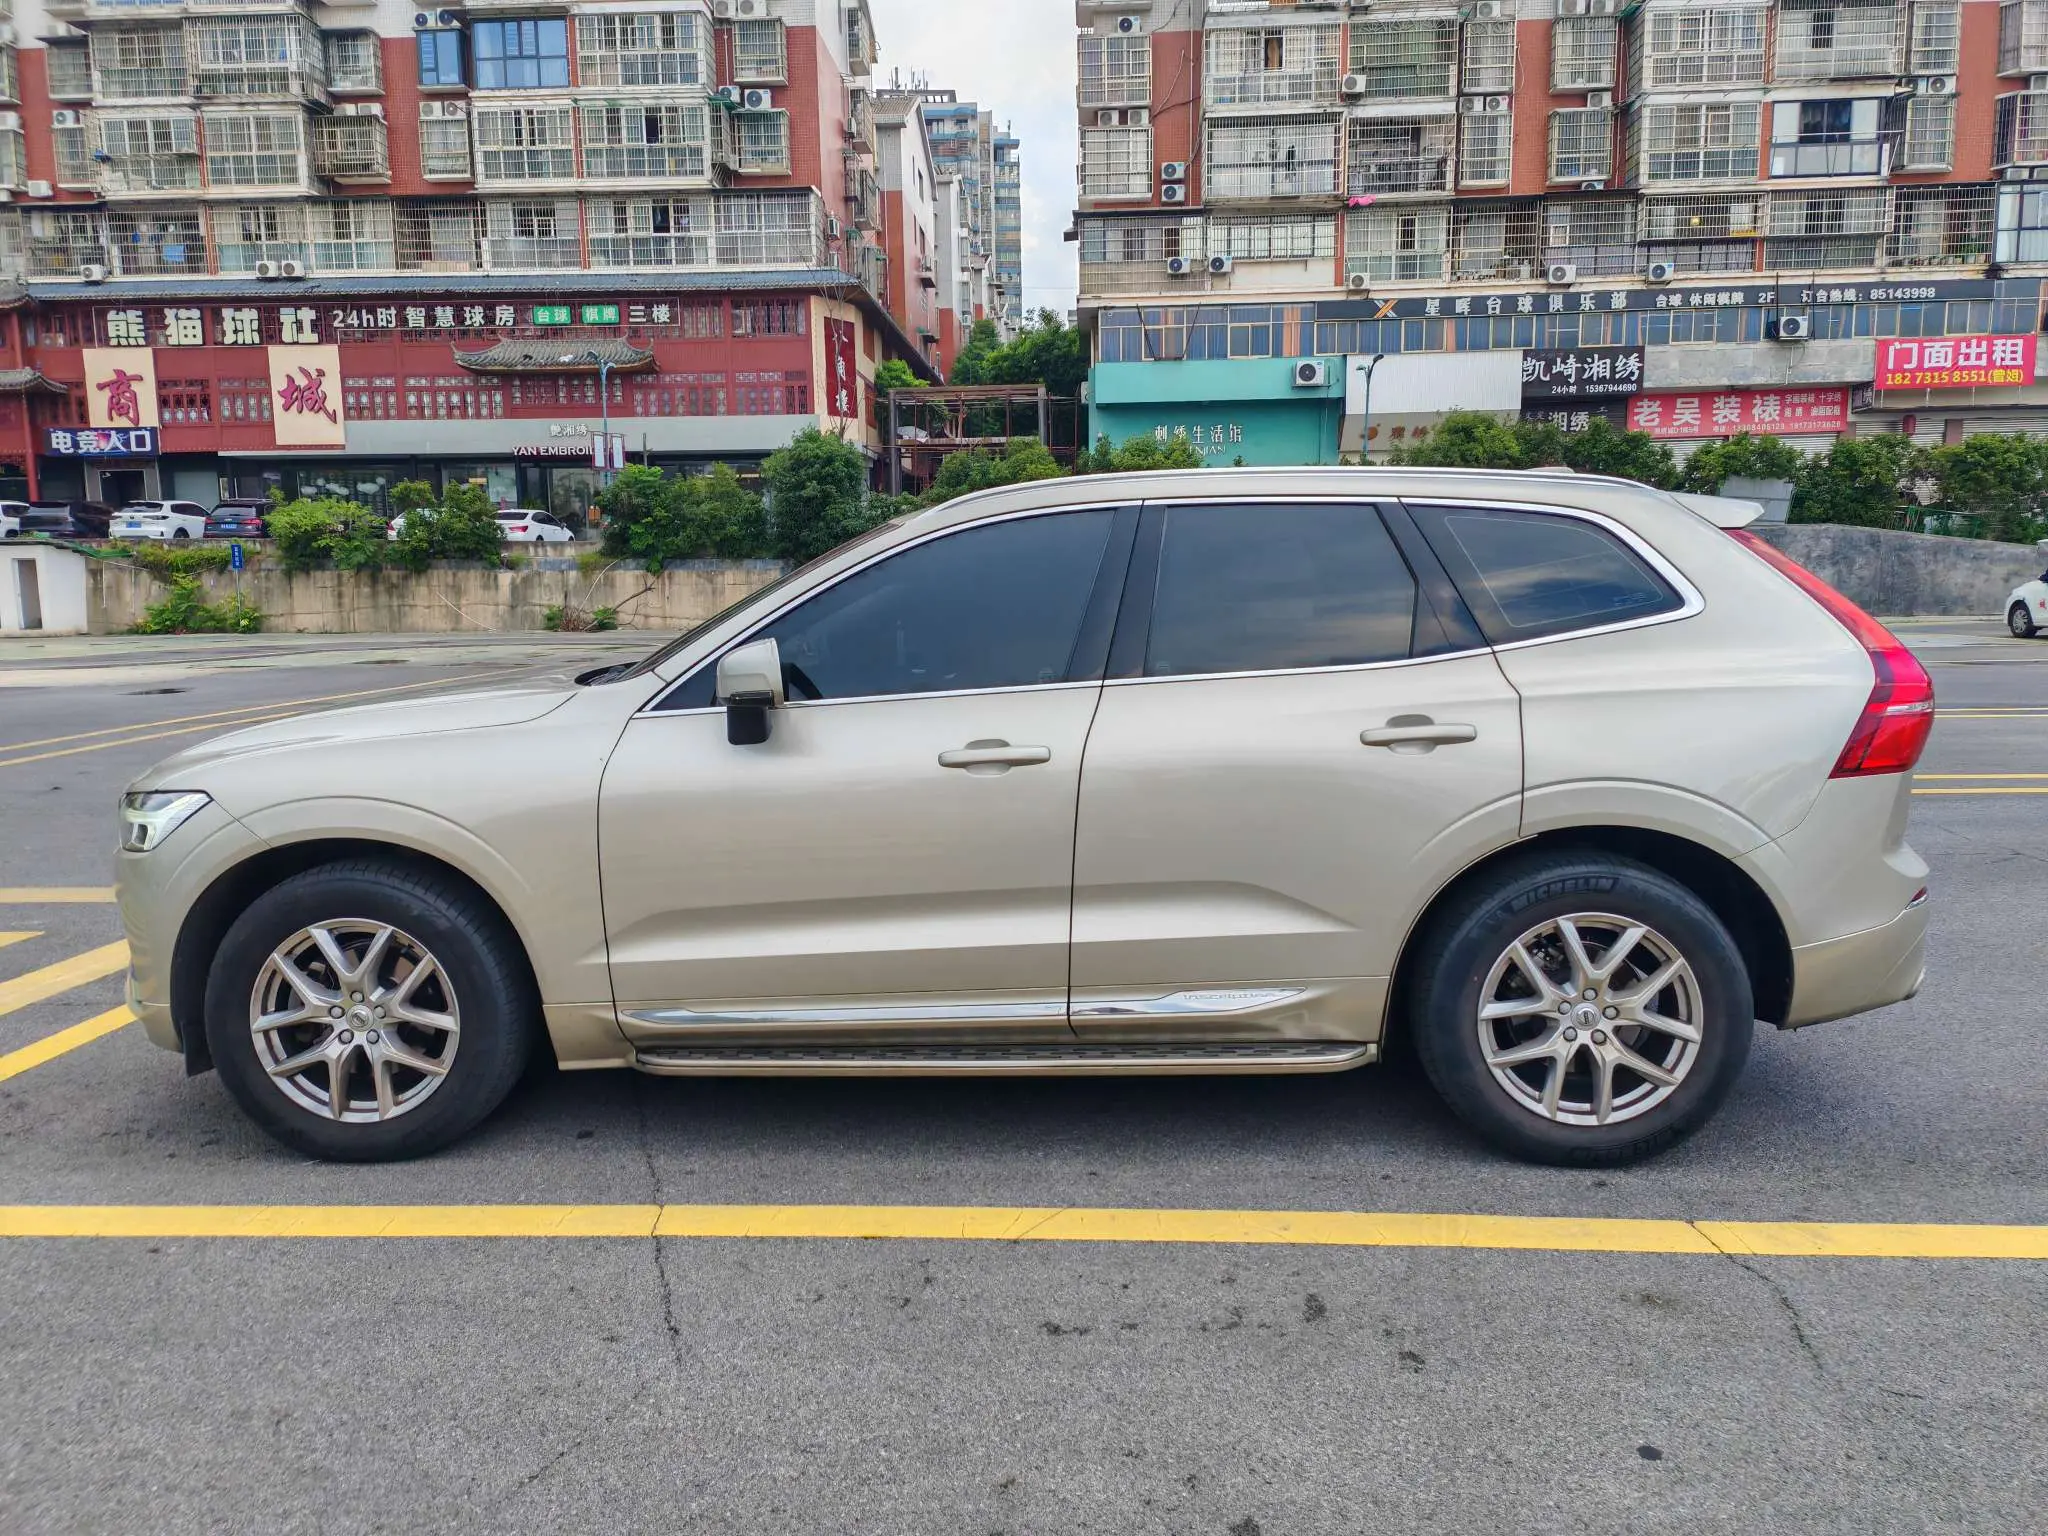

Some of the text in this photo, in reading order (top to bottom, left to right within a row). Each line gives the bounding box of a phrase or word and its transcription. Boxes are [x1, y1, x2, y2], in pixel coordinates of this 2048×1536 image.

[1655, 294, 1683, 308] 台球
[1758, 292, 1776, 304] 2F
[1870, 287, 1936, 300] 85143998
[536, 308, 568, 322] 台球
[586, 306, 616, 321] 棋牌
[629, 303, 671, 323] 三楼
[107, 307, 319, 346] 熊猫球社
[1887, 338, 2024, 370] 门面出租
[1522, 352, 1644, 384] 凯崎湘绣
[1886, 373, 1911, 385] 182
[1915, 371, 1949, 384] 7315
[96, 368, 144, 427] 商
[277, 366, 338, 425] 城
[1551, 383, 1637, 394] 24小时 15367944690
[1633, 394, 1781, 427] 老吴装裱
[1548, 411, 1590, 432] 湘绣
[1154, 423, 1243, 443] 刺绣生活馆
[512, 446, 537, 456] YAN
